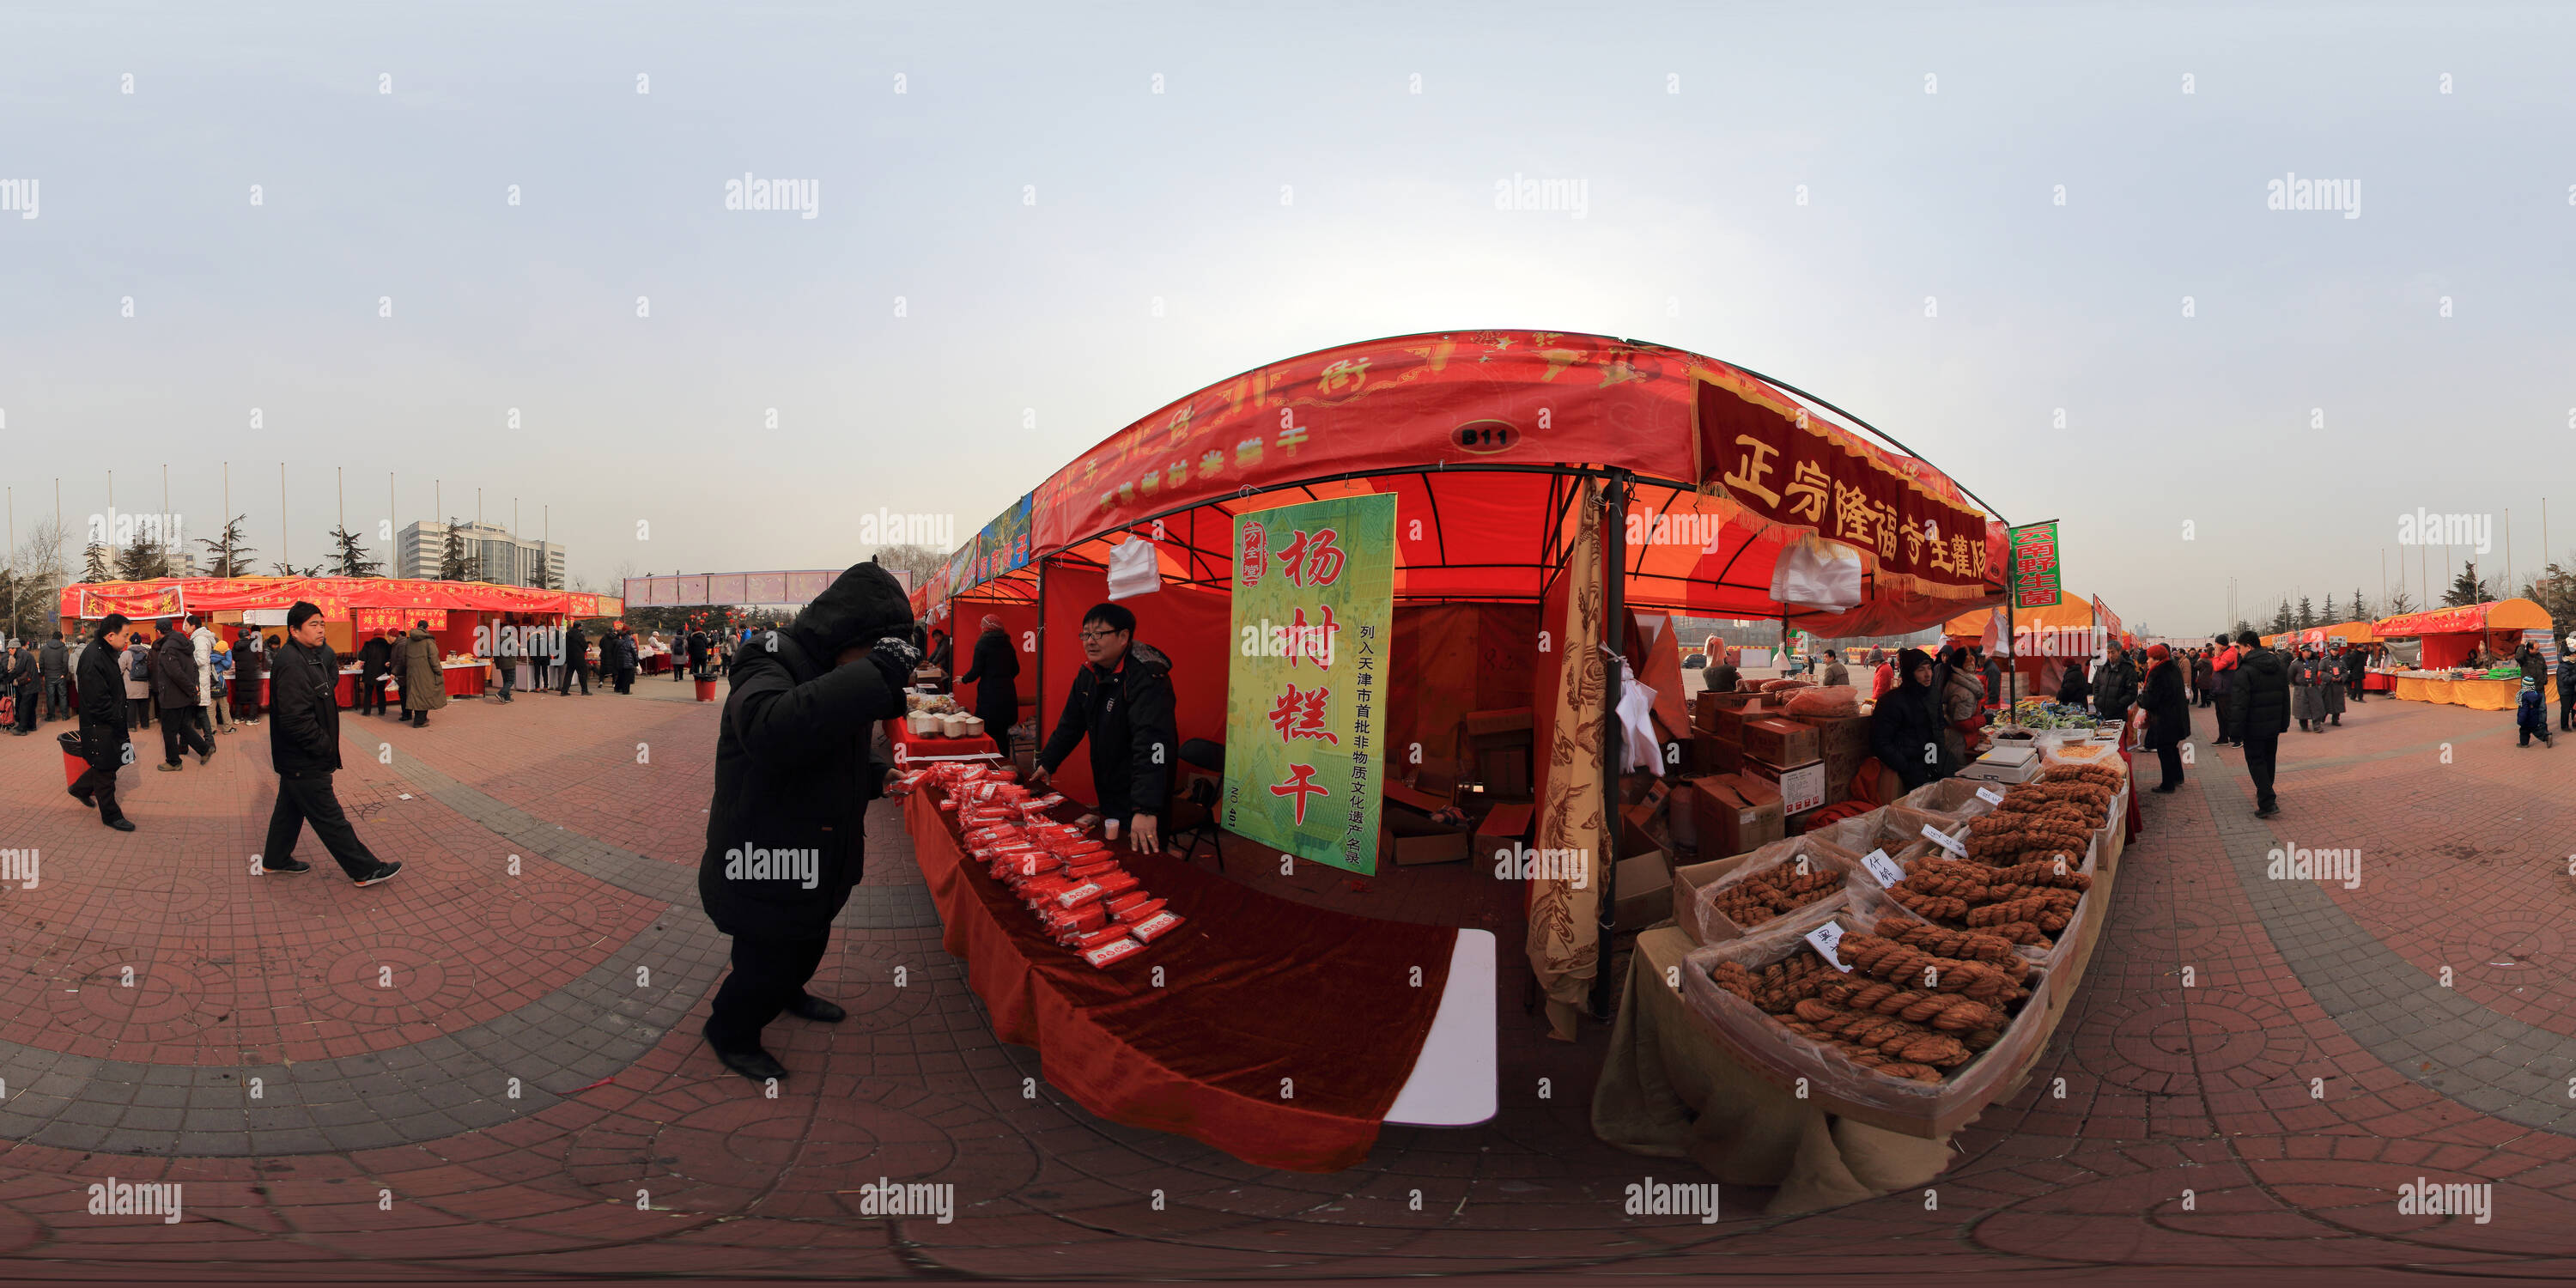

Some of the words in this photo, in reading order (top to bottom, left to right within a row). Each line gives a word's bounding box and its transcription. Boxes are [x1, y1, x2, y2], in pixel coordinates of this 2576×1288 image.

[1461, 429, 1507, 445] B11
[981, 534, 1028, 579] 海南椰子
[2014, 526, 2058, 606] 云南野生菌
[88, 595, 177, 614] 天津大麻花
[1268, 528, 1346, 826] 杨村糕干
[1345, 625, 1376, 865] 列入天津市首批非物质文化遗产名录
[1228, 808, 1237, 828] 401
